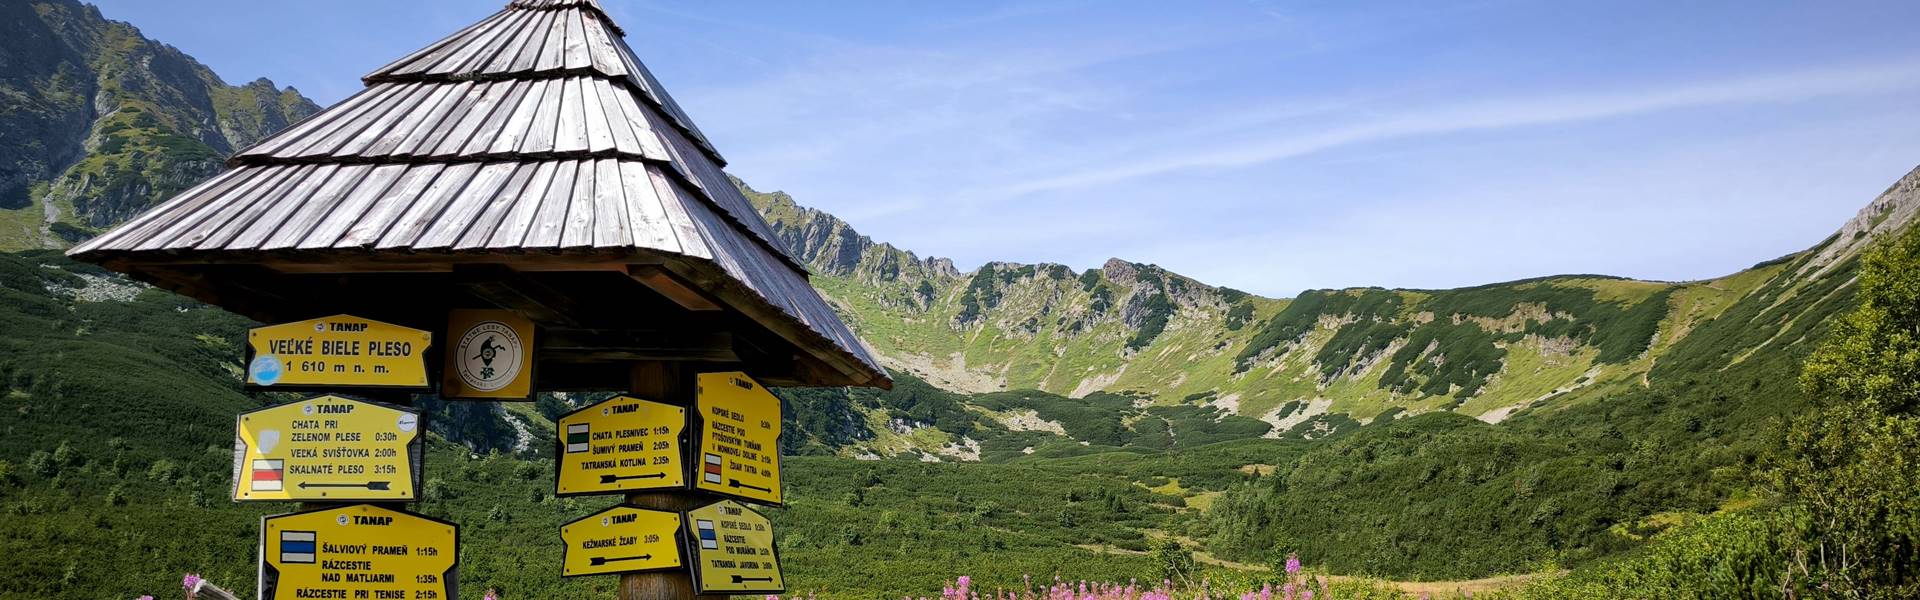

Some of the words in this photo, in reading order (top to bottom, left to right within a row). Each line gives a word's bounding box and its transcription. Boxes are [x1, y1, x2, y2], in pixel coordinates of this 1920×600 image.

[329, 322, 368, 332] TANAP
[270, 337, 313, 355] VEĽKÉ
[322, 341, 360, 355] BIELE
[369, 341, 411, 357] PLESO
[286, 362, 292, 371] 1
[302, 361, 325, 372] 610
[334, 364, 345, 372] m
[354, 364, 365, 373] n.
[374, 364, 389, 373] m.
[735, 378, 753, 390] TANAP
[316, 405, 354, 414] TANAP
[612, 404, 639, 414] TANAP
[292, 420, 321, 429] CHATA
[324, 420, 338, 429] PRI
[291, 433, 330, 441] ZELENOM
[336, 433, 361, 441] PLESE
[375, 433, 397, 441] 0:30h
[592, 432, 612, 440] CHATA
[616, 428, 648, 439] PLESNIVEC
[653, 426, 669, 436] 1:15h
[737, 426, 745, 437] POD
[291, 447, 318, 457] VEĽKÁ
[323, 446, 370, 457] SVIŠŤOVKA
[375, 448, 396, 457] 2:00h
[592, 442, 616, 455] ŠUMIVÝ
[619, 441, 643, 453] PRAMEŇ
[653, 441, 669, 450] 2:05h
[712, 443, 716, 451] V
[290, 462, 333, 474] SKALNATÉ
[338, 465, 364, 474] PLESO
[374, 465, 396, 474] 3:15h
[581, 458, 617, 470] TATRANSKÁ
[620, 458, 646, 467] KOTLINA
[744, 464, 757, 474] TATRA
[724, 507, 742, 516] TANAP
[353, 516, 393, 525] TANAP
[612, 513, 637, 524] TANAP
[582, 538, 616, 549] KEŽMARSKÉ
[644, 534, 659, 544] 3:05h
[322, 542, 367, 554] ŠALVIOVÝ
[372, 544, 408, 555] PRAMEŇ
[416, 547, 438, 556] 1:15h
[726, 546, 735, 554] POD
[322, 558, 371, 570] RÁZCESTIE
[322, 573, 340, 582] NAD
[346, 574, 394, 583] MATLIARMI
[416, 575, 437, 583] 1:35h
[297, 587, 346, 598] RÁZCESTIE
[355, 590, 369, 599] PRI
[375, 590, 405, 599] TENISE
[415, 591, 437, 599] 2:15h
